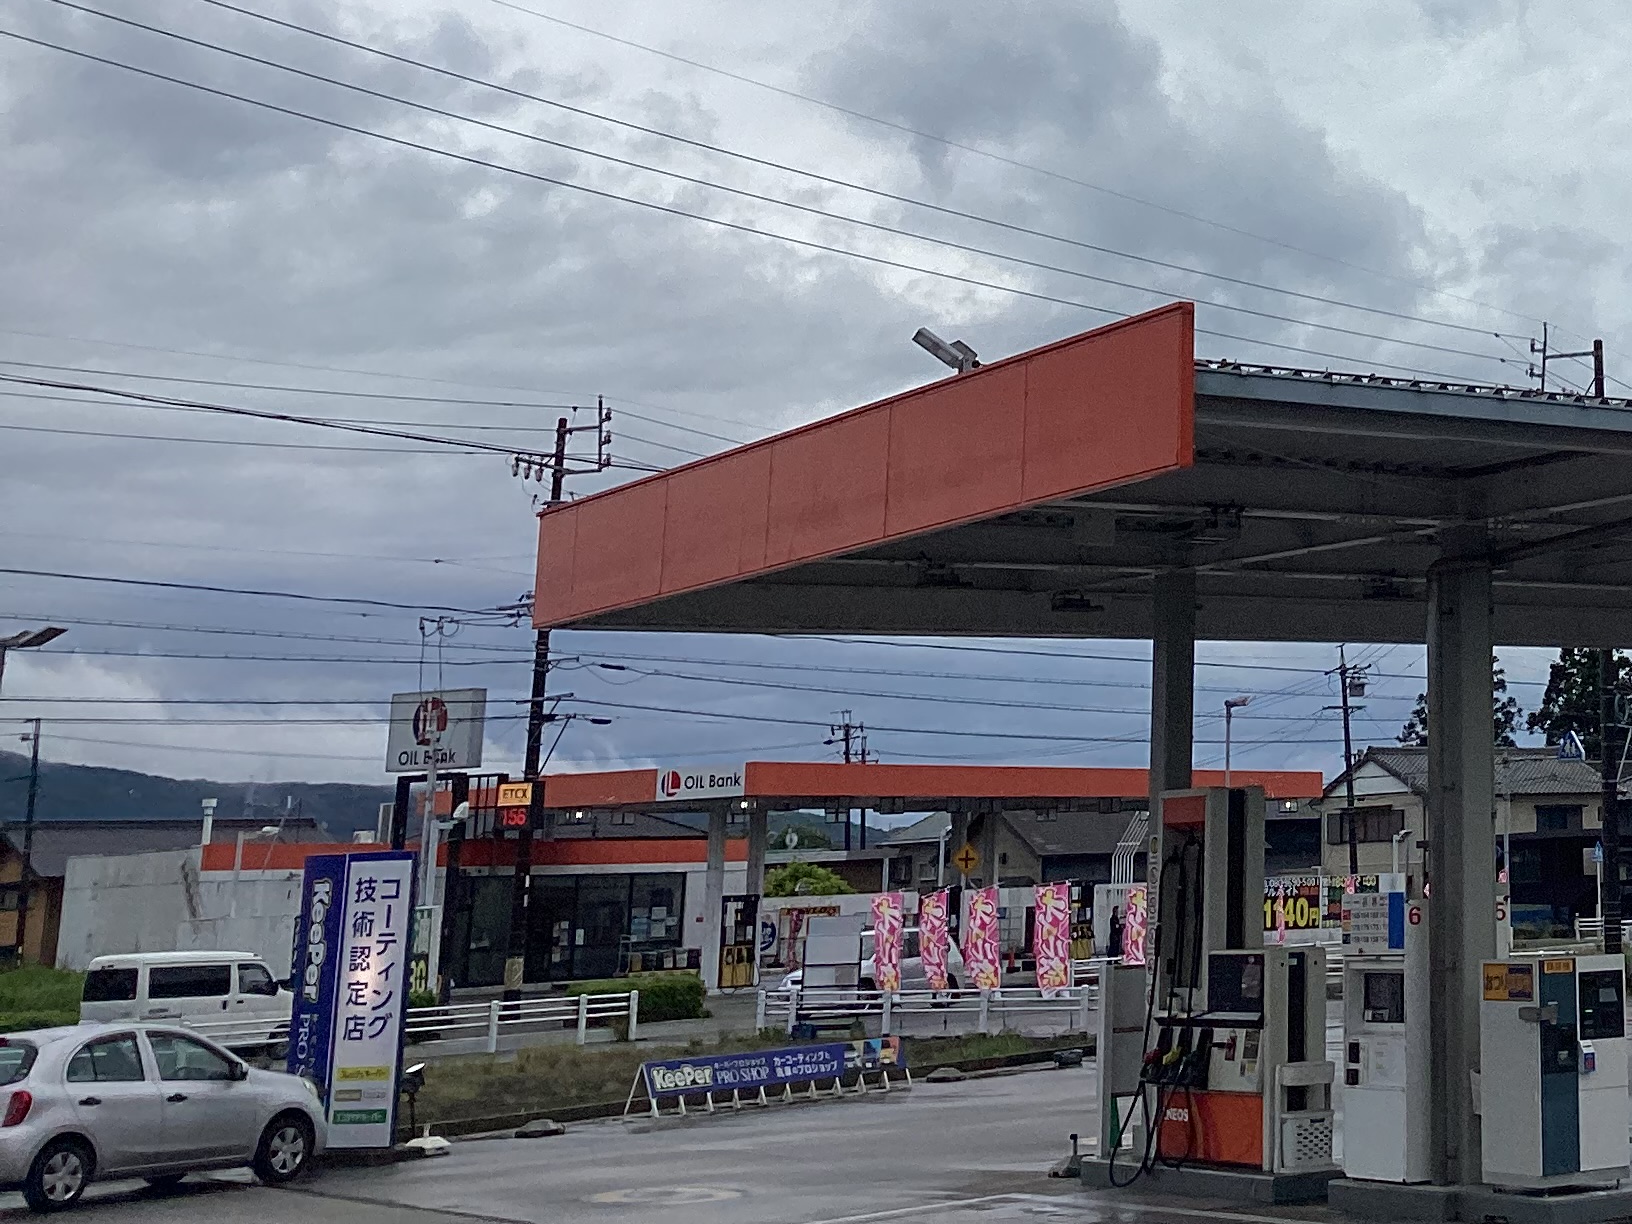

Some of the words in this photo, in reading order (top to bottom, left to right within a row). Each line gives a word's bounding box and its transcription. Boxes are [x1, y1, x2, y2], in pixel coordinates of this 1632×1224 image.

[398, 751, 419, 766] OIL
[684, 775, 705, 790] OIL
[709, 772, 742, 788] Bank
[1408, 906, 1421, 925] 6
[1496, 902, 1506, 921] 5
[303, 878, 332, 1003] KeePer
[343, 877, 378, 1041] 技術認定店
[368, 879, 401, 1039] コーティング
[297, 1014, 310, 1058] PRO
[652, 1064, 713, 1090] KeePer
[716, 1069, 740, 1084] PRO
[740, 1066, 769, 1081] SHOP
[1164, 1108, 1189, 1121] NEOS
